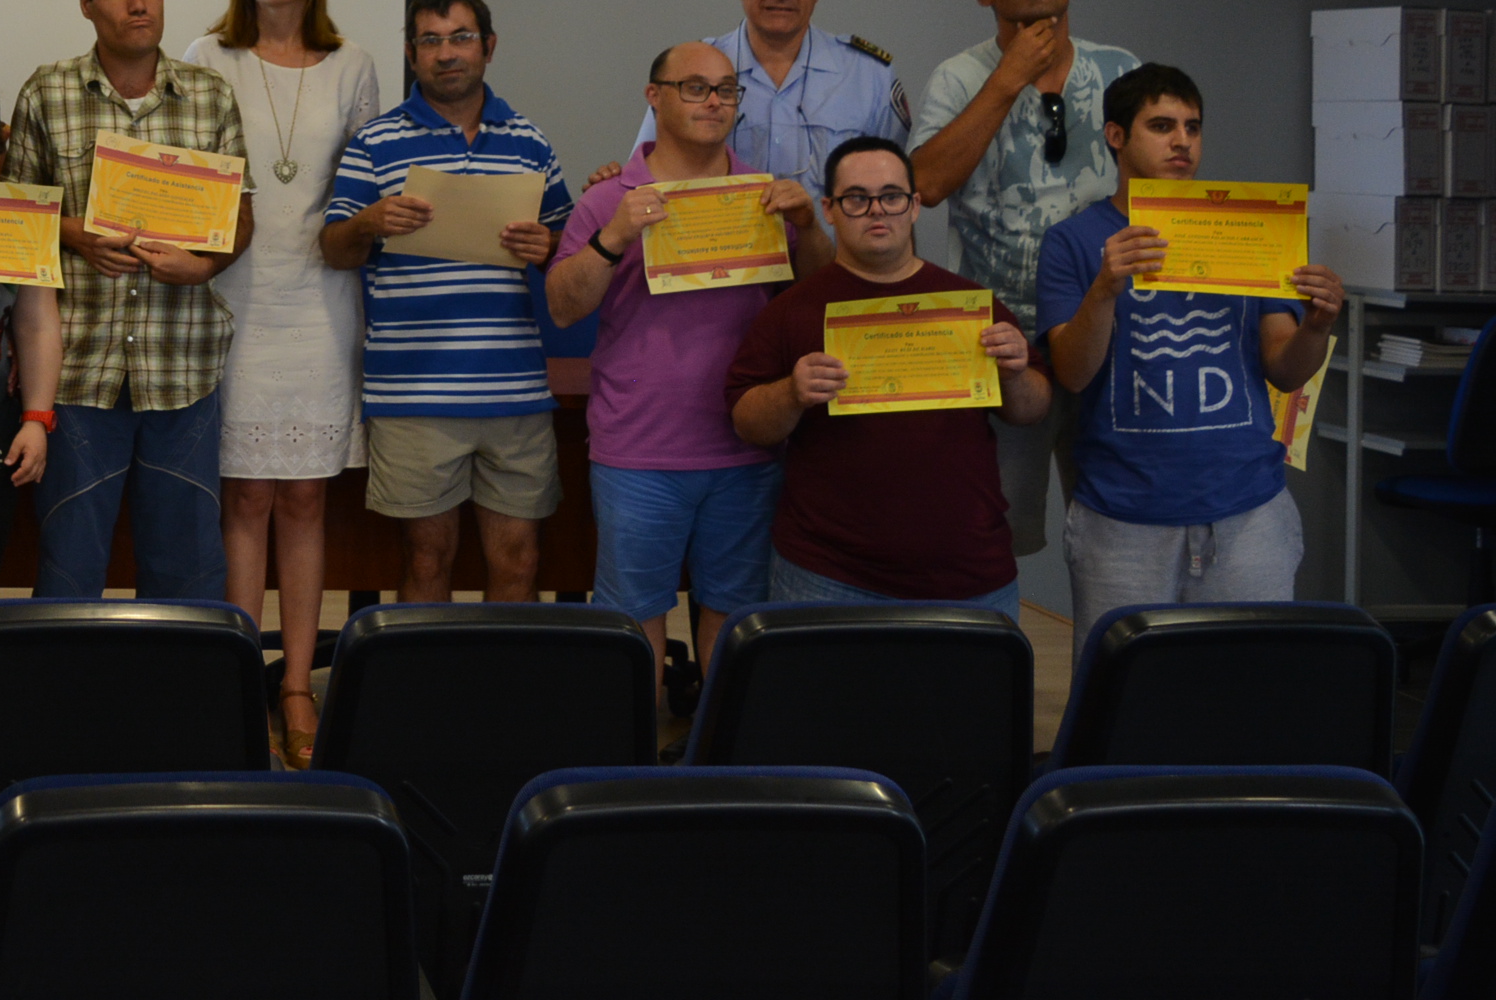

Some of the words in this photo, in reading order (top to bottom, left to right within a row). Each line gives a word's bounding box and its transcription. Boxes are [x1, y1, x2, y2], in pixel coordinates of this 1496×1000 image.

[125, 171, 161, 184] Certificado
[171, 180, 204, 192] Asistencia
[1171, 217, 1212, 226] Certificado
[1224, 219, 1264, 228] Asistencia
[677, 247, 709, 255] Asistencia
[719, 242, 753, 251] Certificado
[864, 330, 903, 340] Certificado
[905, 330, 914, 338] de
[915, 329, 954, 337] Asistencia
